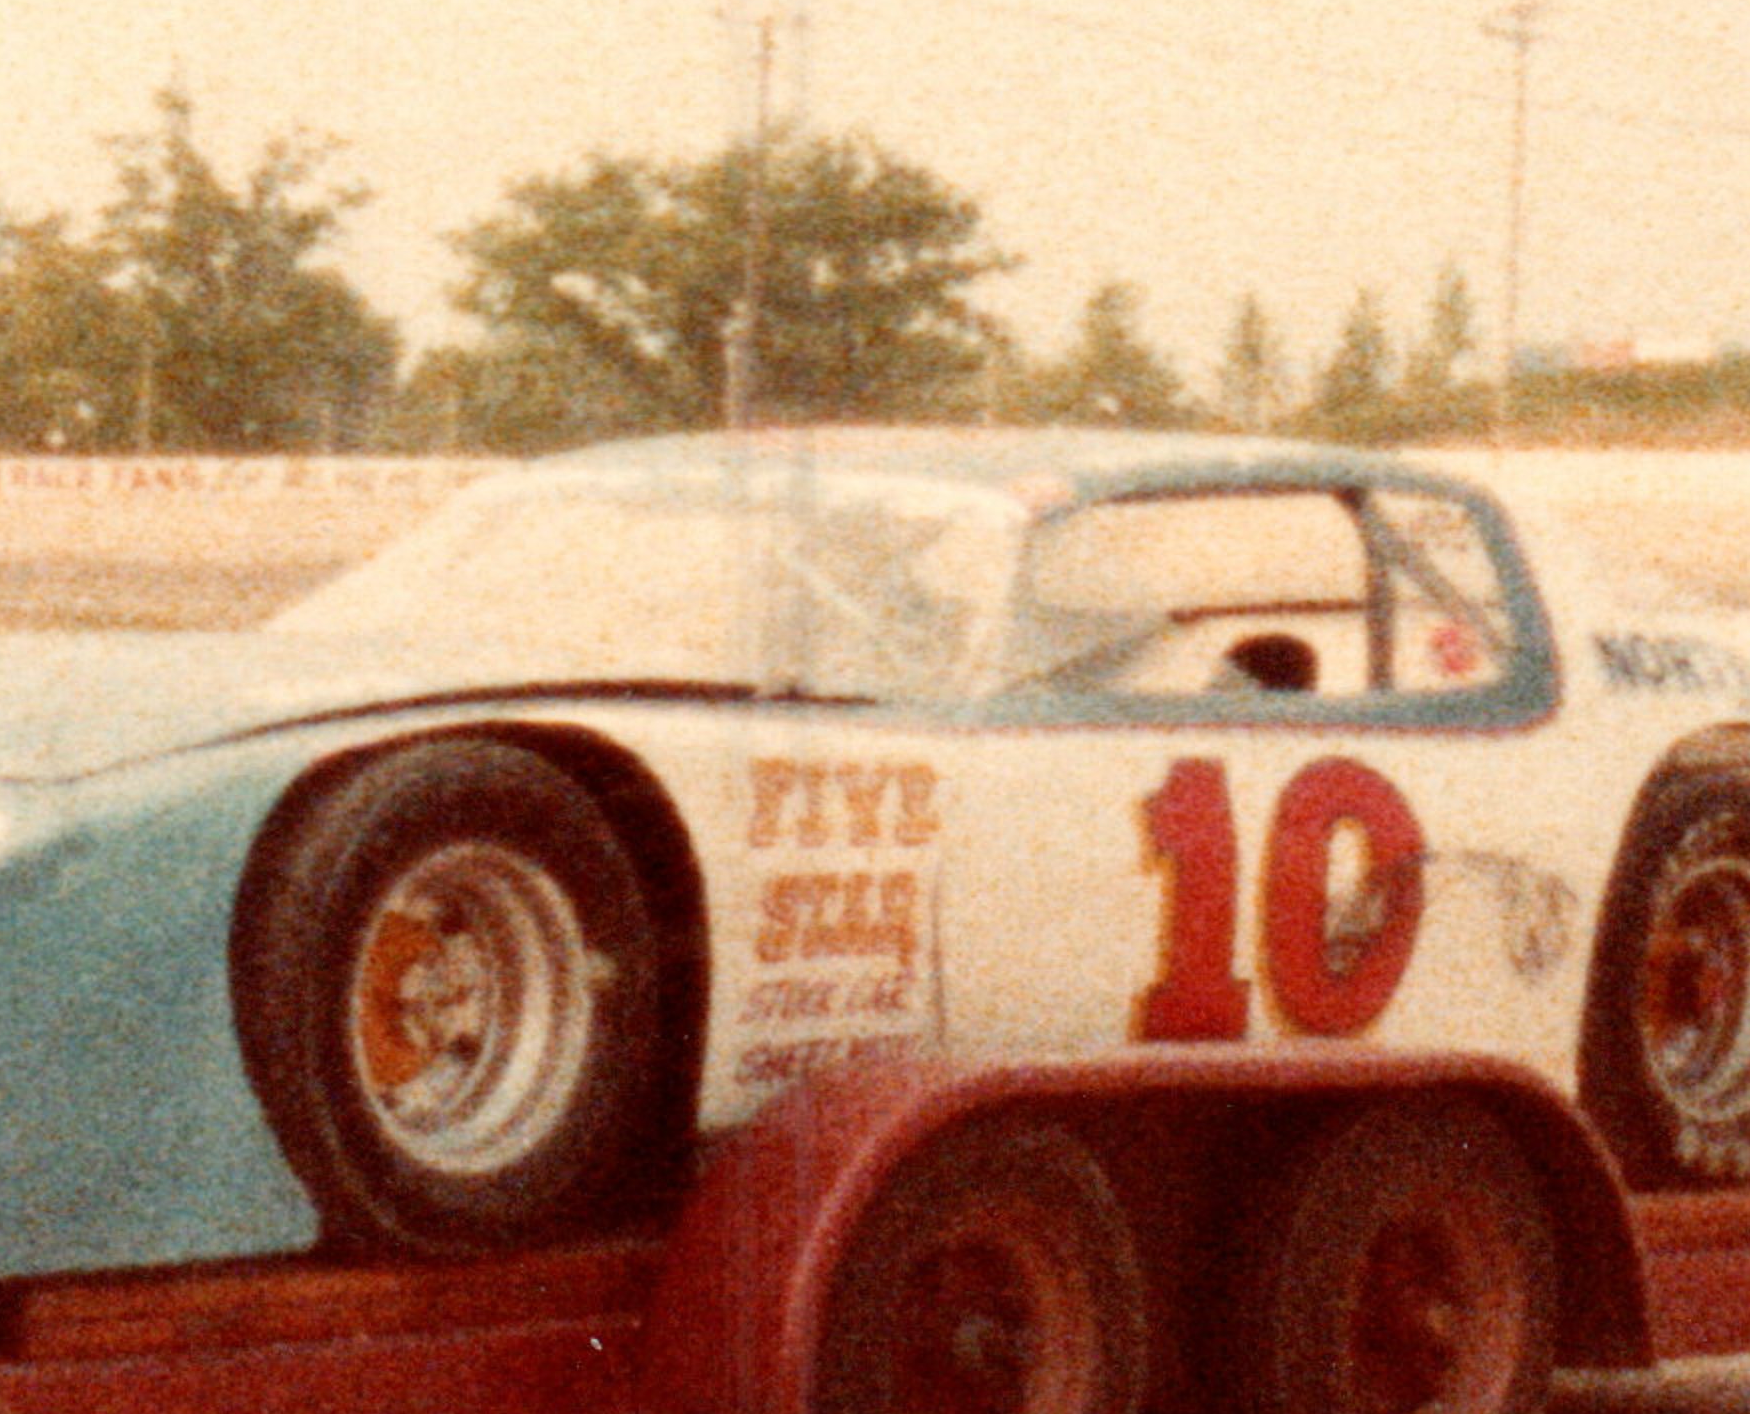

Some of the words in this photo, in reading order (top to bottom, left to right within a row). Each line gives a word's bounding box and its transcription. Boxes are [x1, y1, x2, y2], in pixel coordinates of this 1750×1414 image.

[749, 756, 941, 849] FIVE
[753, 871, 919, 970] STAR
[1127, 754, 1427, 1042] 10
